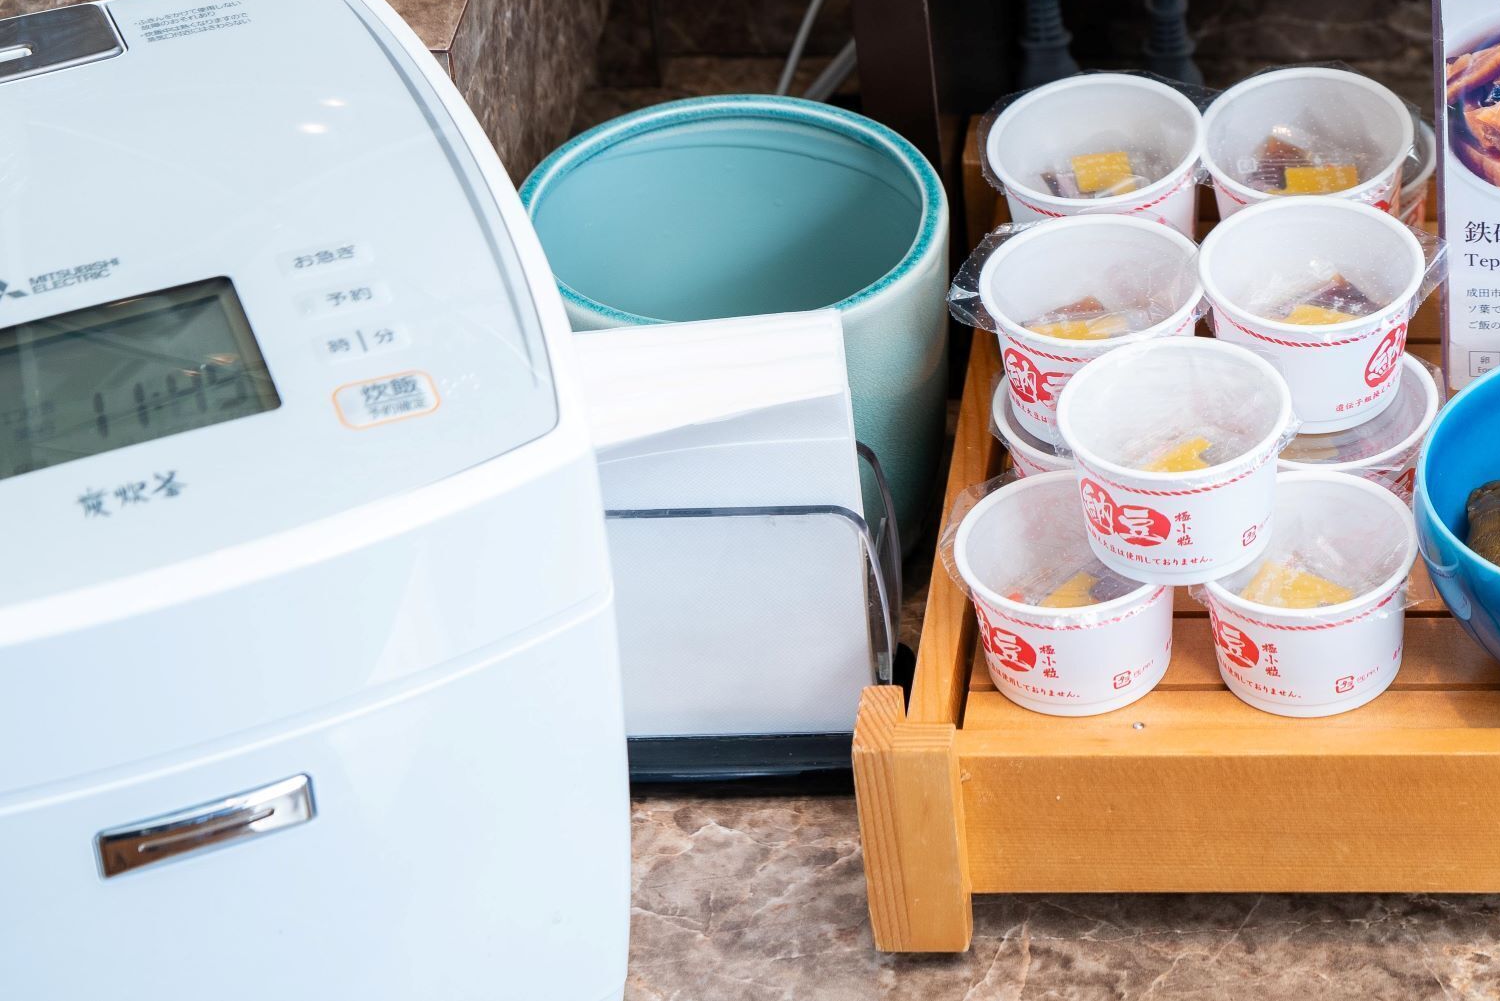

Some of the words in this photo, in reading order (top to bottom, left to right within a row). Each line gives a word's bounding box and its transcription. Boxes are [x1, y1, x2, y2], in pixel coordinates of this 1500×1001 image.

[294, 245, 355, 269] お急ぎ
[29, 258, 120, 285] MITSUBISHI
[31, 270, 111, 294] ELECTRIC
[326, 287, 373, 306] 予約
[374, 328, 394, 344] 分
[1081, 480, 1170, 543] 納豆
[1174, 511, 1193, 546] 極小粒
[1039, 645, 1059, 678] 極小粒
[1262, 643, 1280, 677] 極小粒
